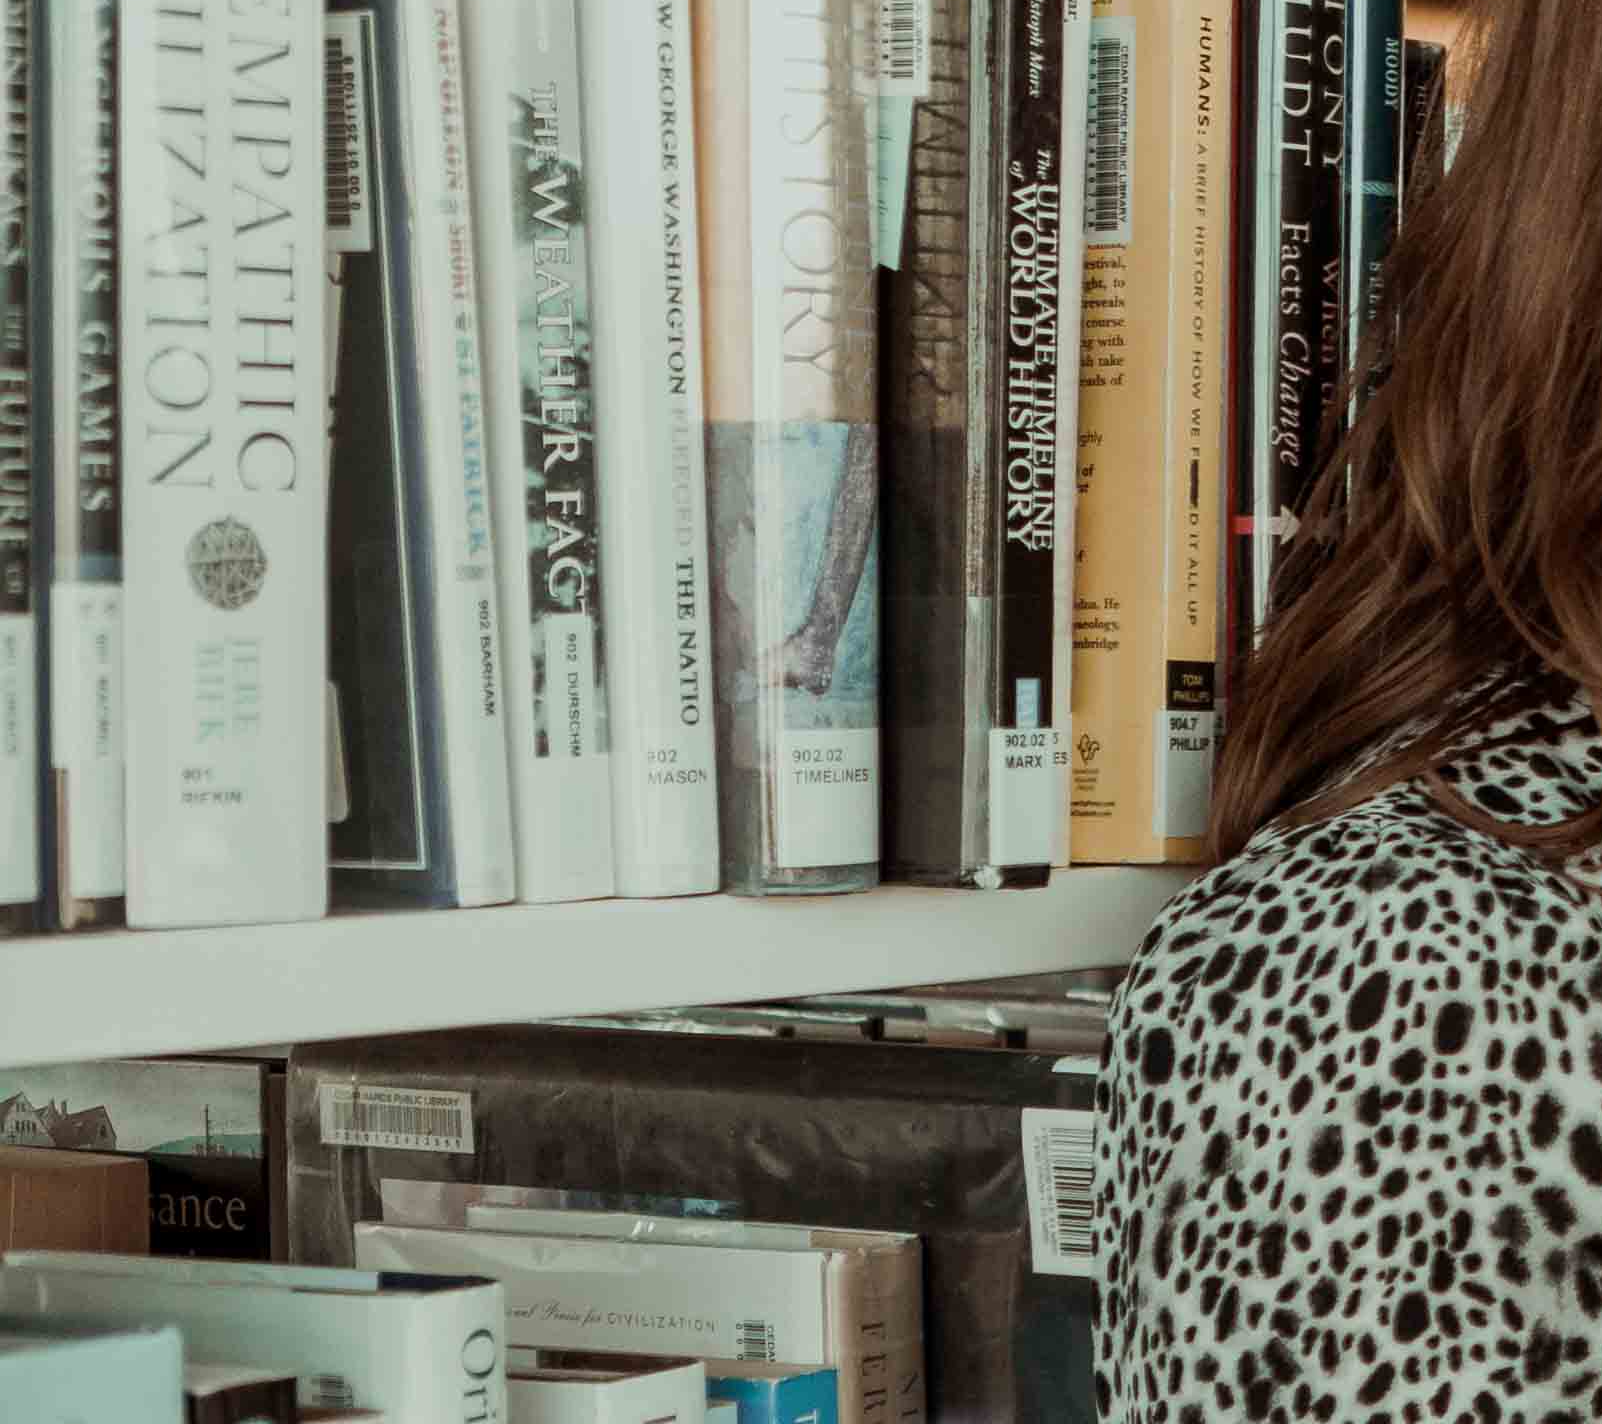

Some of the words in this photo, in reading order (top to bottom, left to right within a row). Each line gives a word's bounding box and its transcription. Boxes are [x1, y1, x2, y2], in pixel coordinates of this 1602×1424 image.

[1028, 51, 1046, 98] Marx
[1120, 45, 1129, 84] CEDAR
[1196, 16, 1213, 136] HUMANS:
[1384, 36, 1400, 111] MOODY
[529, 79, 561, 161] THE
[657, 38, 680, 166] GEORGE
[1120, 87, 1129, 128] RAPIDS
[1009, 161, 1025, 181] of
[1036, 149, 1053, 181] The
[1119, 131, 1128, 171] PUBLIC
[1118, 174, 1128, 223] LIBRARY
[1194, 162, 1208, 218] BRIEF
[664, 180, 688, 394] WASHINGTON
[1009, 183, 1037, 347] WORLD
[1034, 184, 1059, 366] ULTIMATE
[1192, 226, 1207, 308] HISTORY
[1281, 220, 1311, 317] Facts
[530, 170, 585, 470] WEATHER
[1191, 314, 1205, 338] OF
[1190, 350, 1204, 400] HOW
[1270, 330, 1312, 468] Change
[80, 320, 114, 510] GAMES
[1189, 408, 1202, 437] WE
[1007, 360, 1036, 551] HISTORY
[1031, 374, 1057, 551] TIMELINE
[675, 558, 695, 620] THE
[1186, 558, 1200, 593] ALL
[476, 598, 490, 627] 902
[1186, 600, 1200, 627] UP
[478, 632, 496, 718] BARHAM
[678, 630, 702, 728] NATIO
[563, 671, 582, 759] DURSCHM
[1169, 717, 1198, 732] 904.7
[646, 750, 678, 764] 902
[791, 748, 845, 764] 902.02
[1005, 733, 1046, 749] 902.02
[1005, 754, 1044, 770] MARX
[792, 767, 871, 785] TIMELINES
[606, 1311, 717, 1334] CIVILIZATION
